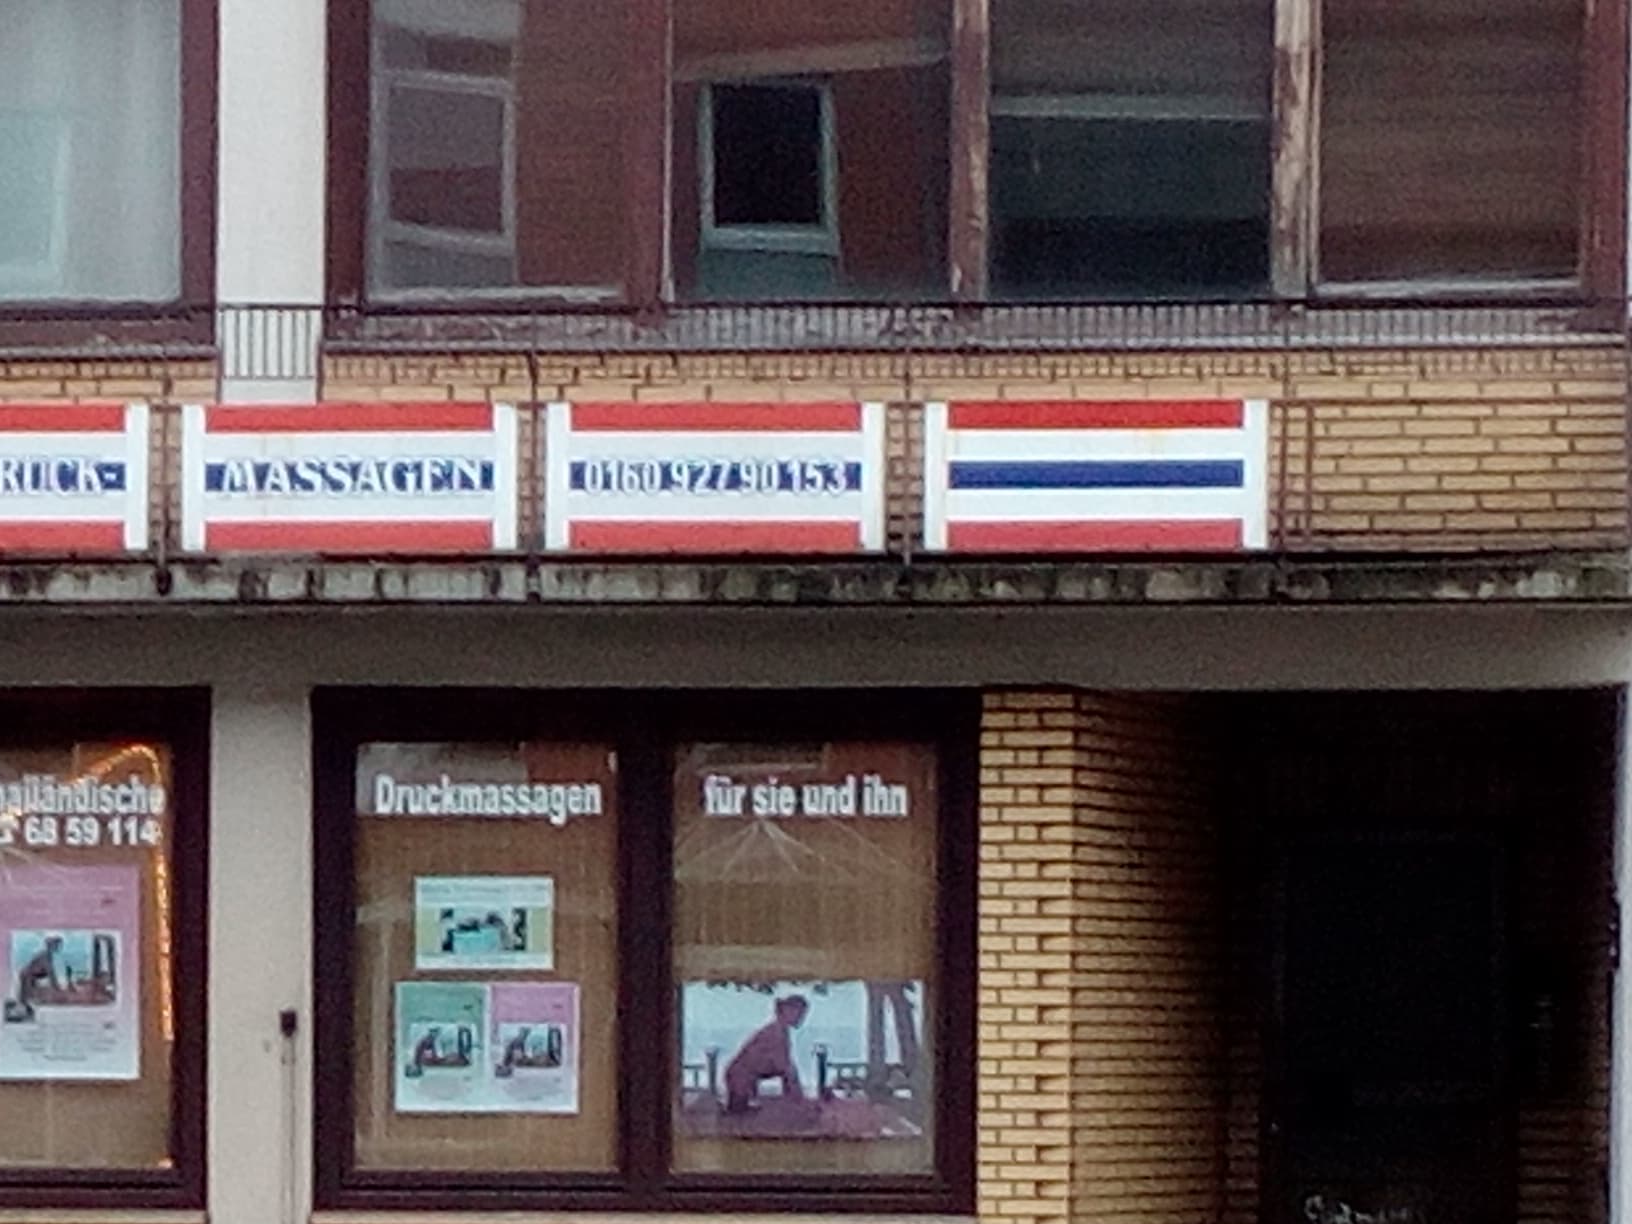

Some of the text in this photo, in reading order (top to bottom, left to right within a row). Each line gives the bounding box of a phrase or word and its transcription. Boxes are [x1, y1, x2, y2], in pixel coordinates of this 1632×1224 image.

[218, 454, 485, 498] MASSAGEN
[584, 456, 847, 497] 0160 927 90 153
[375, 772, 603, 827] Druckmassagen
[704, 773, 908, 816] für sie und ihn
[24, 815, 163, 845] 68 59 114
